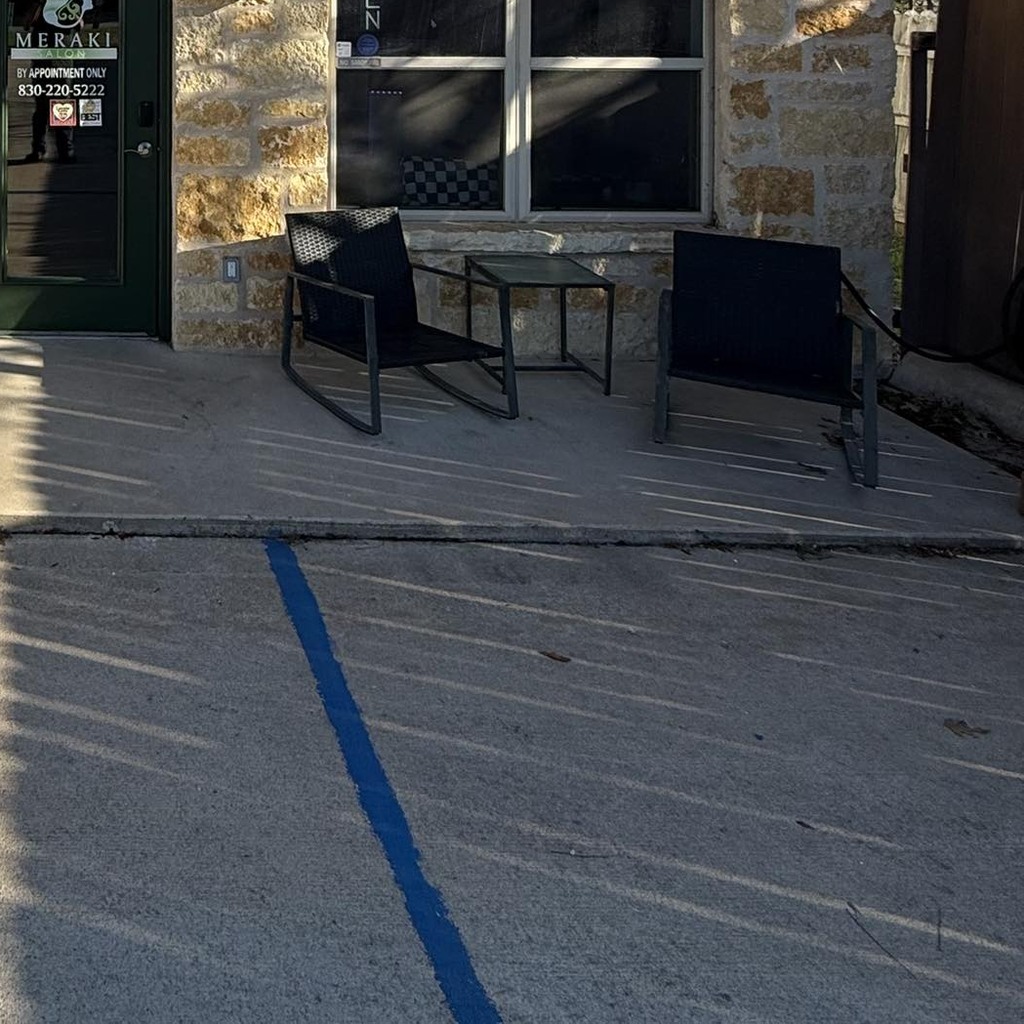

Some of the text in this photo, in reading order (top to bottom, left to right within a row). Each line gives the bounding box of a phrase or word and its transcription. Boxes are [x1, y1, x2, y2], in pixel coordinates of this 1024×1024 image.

[16, 32, 111, 48] MERAKI
[17, 67, 107, 78] BY APPOINTMENT ONLY
[18, 84, 105, 96] 830-220-5222
